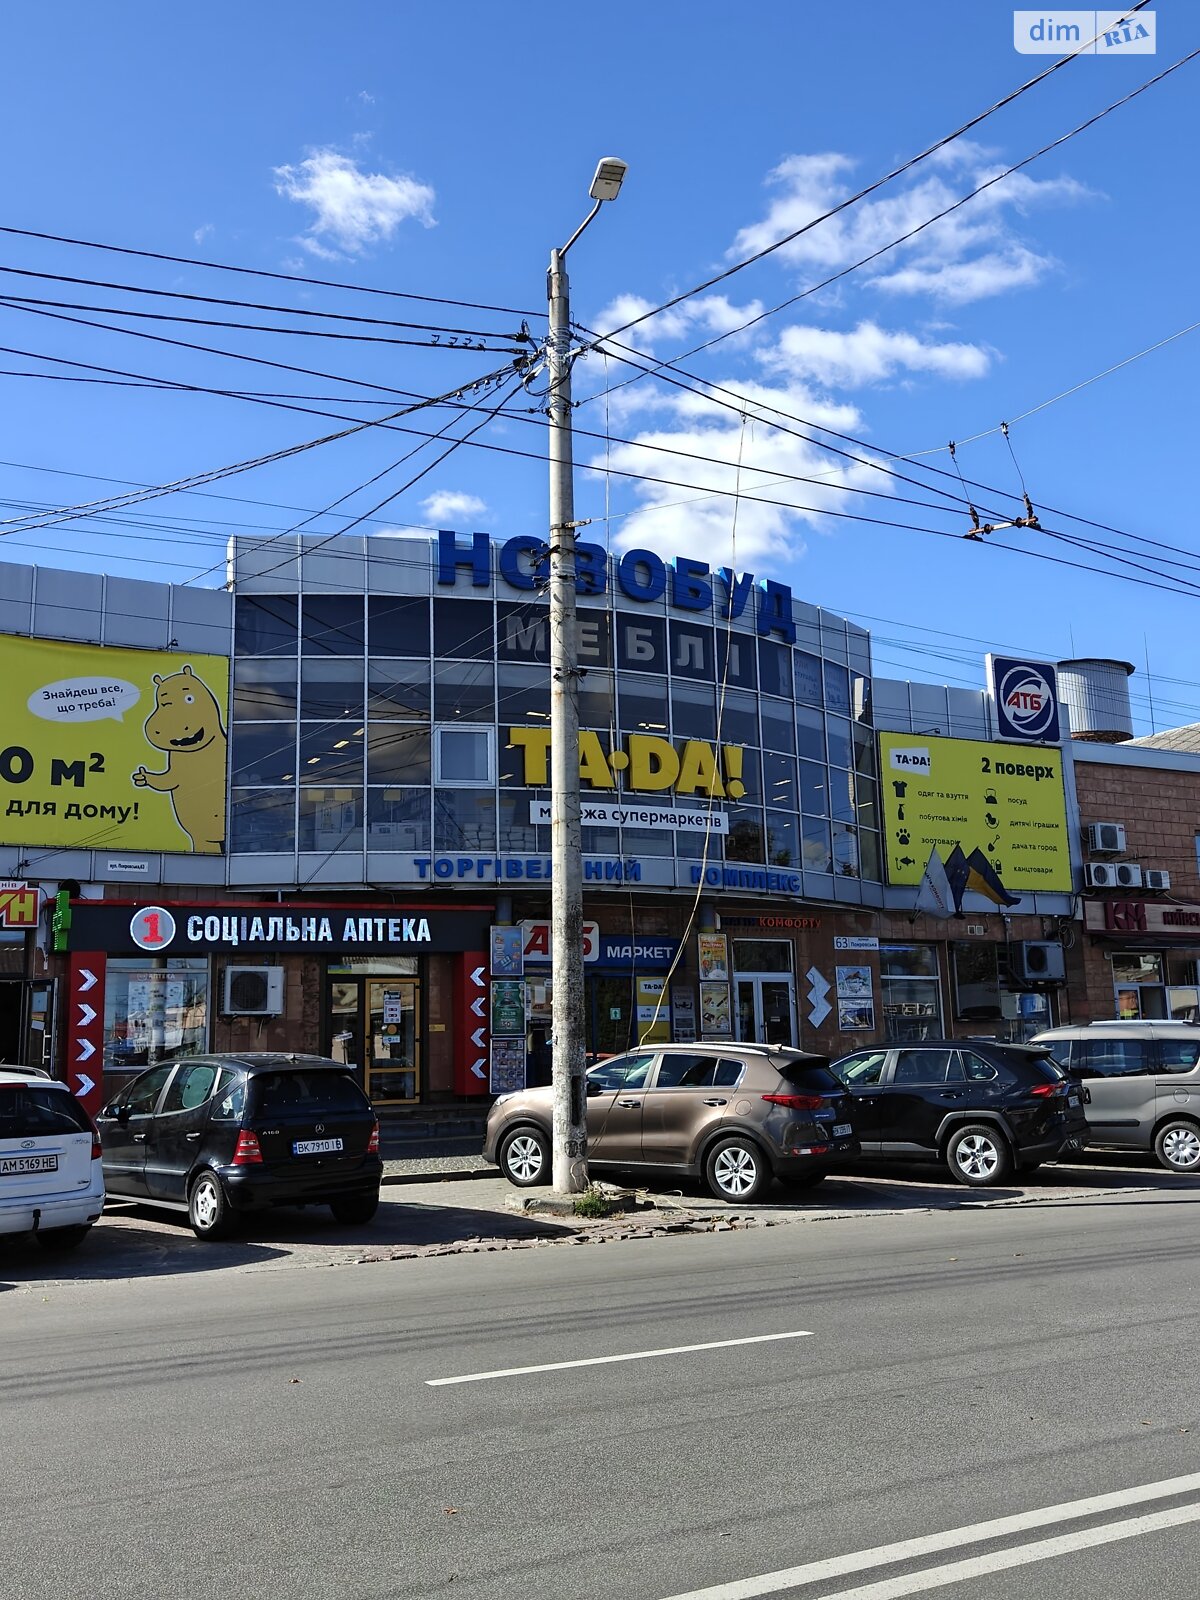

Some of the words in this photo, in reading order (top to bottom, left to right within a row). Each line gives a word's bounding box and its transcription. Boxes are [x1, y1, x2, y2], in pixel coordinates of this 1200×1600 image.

[438, 530, 797, 644] НОВОБУД
[506, 615, 740, 677] МЕБЛІ
[43, 684, 98, 700] Знайдеш
[100, 684, 124, 696] все,
[57, 703, 76, 714] що
[77, 697, 117, 712] треба!
[1007, 691, 1042, 711] АТБ
[981, 757, 991, 773] 2
[995, 762, 1054, 781] поверх
[917, 790, 935, 798] одяг
[946, 793, 969, 801] взуття
[1008, 797, 1028, 805] посуд
[6, 799, 57, 817] для
[64, 801, 140, 824] дому!
[611, 809, 722, 829] супермаркетів
[919, 813, 951, 822] побутова
[1009, 820, 1031, 828] дитячі
[1032, 820, 1059, 829] іграшки
[1038, 844, 1057, 852] город
[414, 858, 642, 882] ТОРГІВЕНИЙ
[1013, 865, 1053, 874] канцтовари
[691, 865, 801, 892] КОМПЛЕКС
[142, 913, 164, 943] 1
[187, 915, 333, 946] СОЦІАЛЬНА
[342, 917, 432, 943] АПТЕКА
[759, 916, 823, 929] КОМФОРТУ
[836, 937, 849, 949] 63
[606, 946, 674, 959] МАРКЕТ
[298, 1143, 310, 1152] BK
[311, 1141, 330, 1151] 7910
[2, 1161, 17, 1172] AM
[19, 1158, 40, 1170] 5169
[42, 1157, 55, 1168] HE
